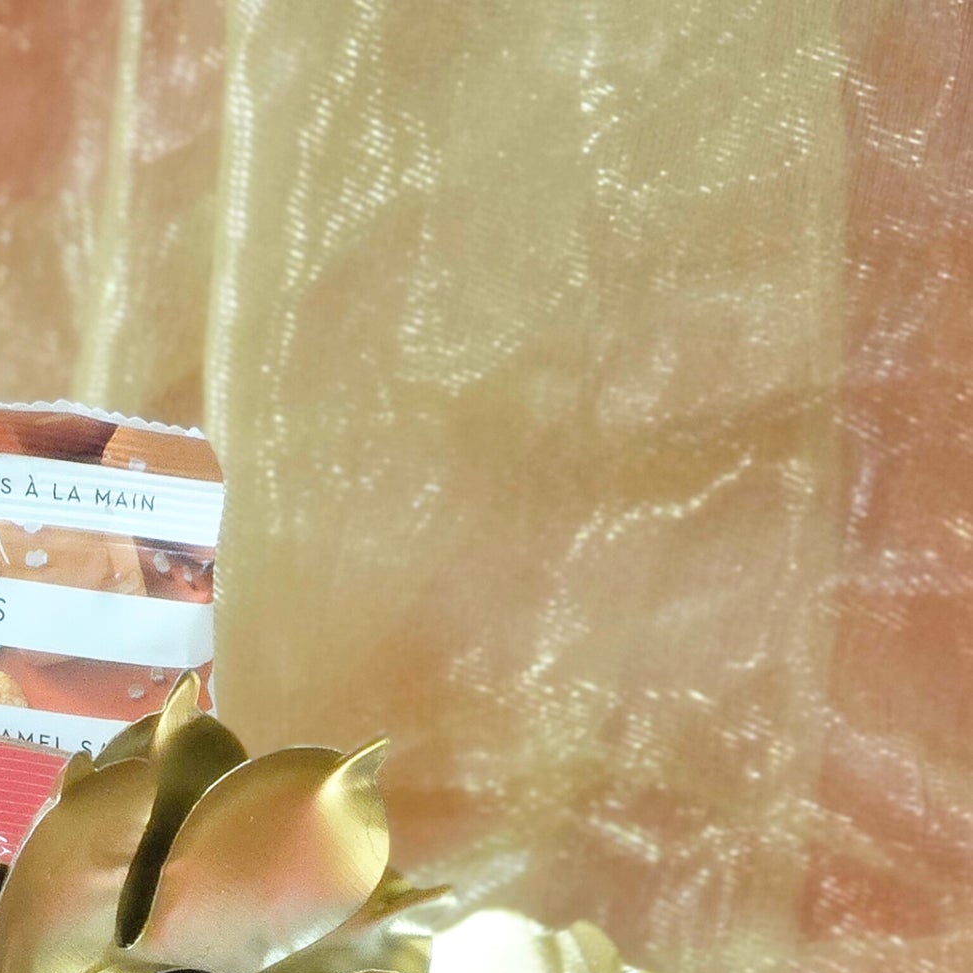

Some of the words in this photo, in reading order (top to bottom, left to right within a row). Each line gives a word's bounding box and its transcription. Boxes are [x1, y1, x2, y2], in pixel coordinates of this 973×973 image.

[25, 474, 39, 498] À
[53, 483, 81, 502] LA
[95, 488, 155, 512] MAIN
